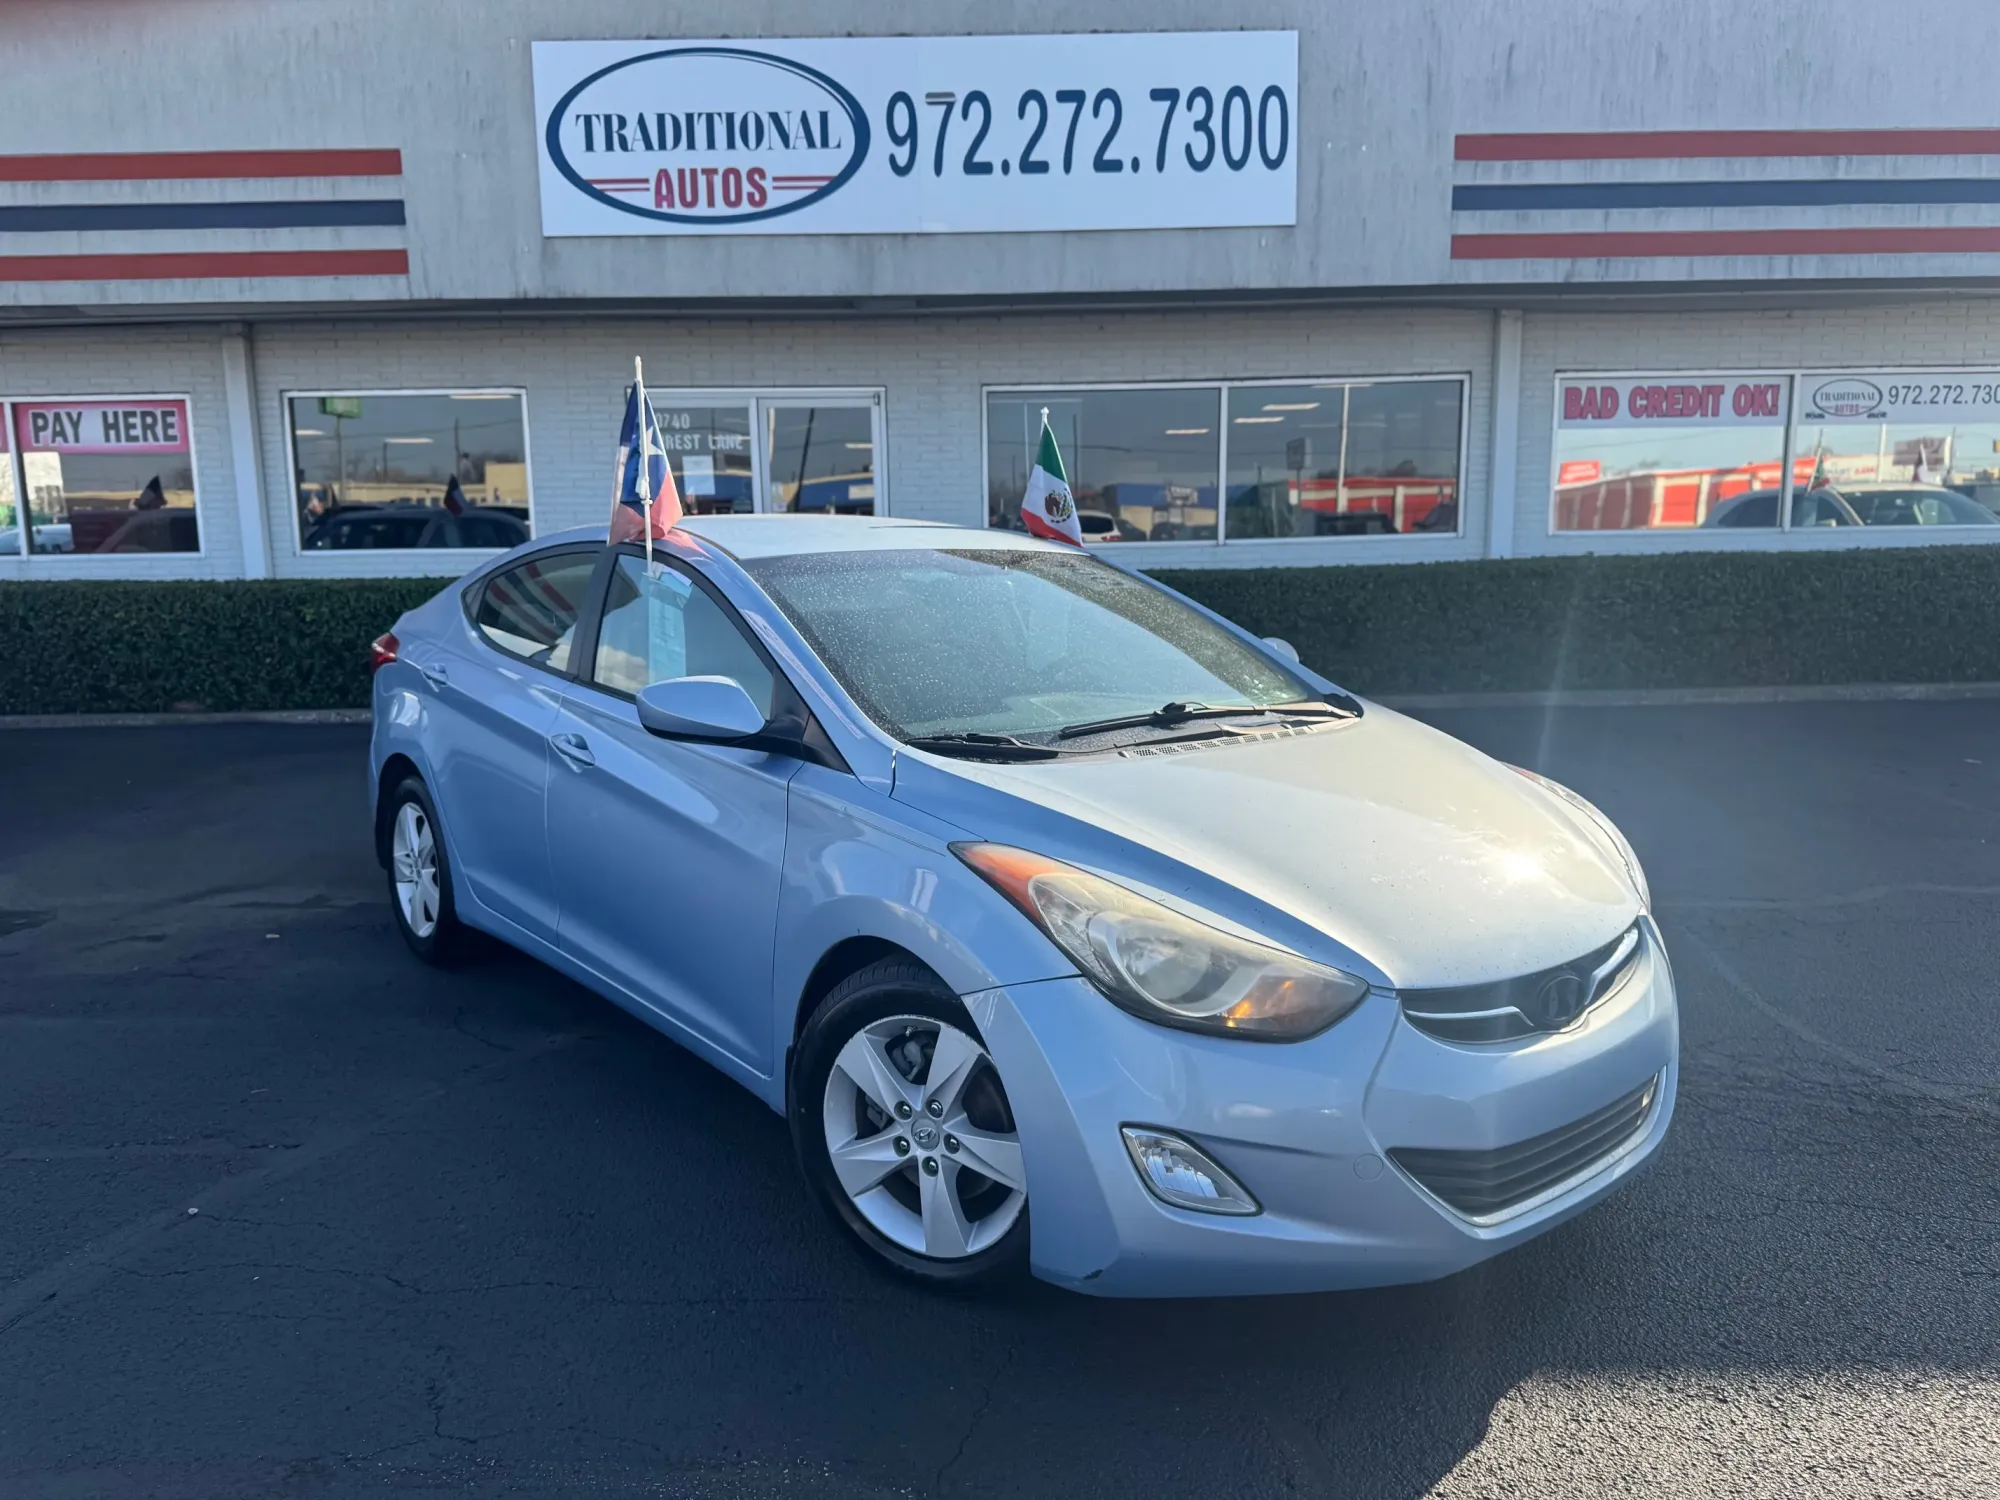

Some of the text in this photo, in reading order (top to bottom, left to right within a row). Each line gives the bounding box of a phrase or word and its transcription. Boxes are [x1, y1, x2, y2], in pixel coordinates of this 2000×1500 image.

[575, 110, 842, 153] TRADITIONAL
[886, 85, 1289, 177] 972.272.7300
[655, 166, 767, 209] AUTOS
[1563, 383, 1780, 420] BAD CREDIT OK!
[1820, 391, 1876, 402] TRADITIONAL
[1834, 403, 1860, 414] AUTOS
[30, 409, 179, 444] PAY HERE
[662, 434, 744, 450] REST LANE
